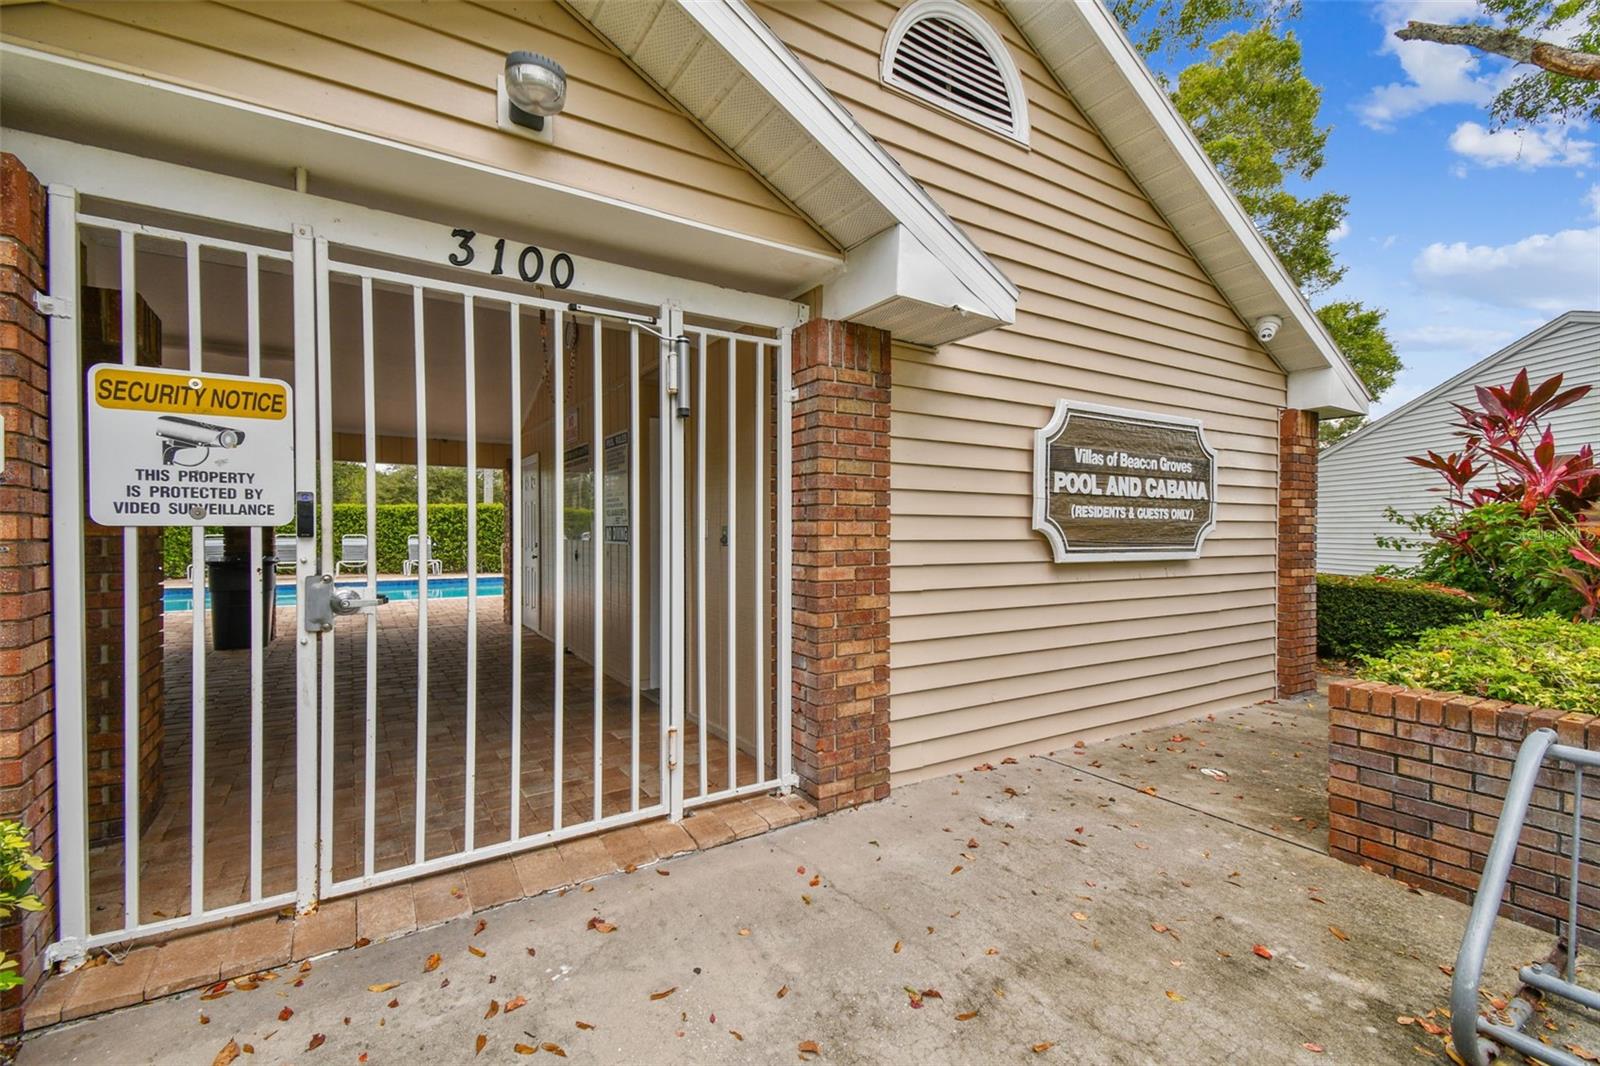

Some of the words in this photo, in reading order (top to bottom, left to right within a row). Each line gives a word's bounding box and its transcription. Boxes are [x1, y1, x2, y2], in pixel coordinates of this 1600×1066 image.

[448, 228, 575, 290] 3100
[98, 378, 207, 407] SECURITY
[210, 387, 285, 413] NOTICE
[1074, 447, 1104, 466] Villas
[1106, 451, 1119, 466] of
[1120, 452, 1158, 471] Beacon
[1160, 456, 1193, 473] Groves
[135, 468, 170, 482] THIS
[178, 469, 256, 485] PROPERTY
[1053, 471, 1103, 496] POOL
[1106, 475, 1142, 498] AND
[1145, 477, 1209, 500] CABANA
[126, 484, 141, 498] IS
[149, 485, 237, 500] PROTECTED
[244, 487, 264, 500] BY
[113, 501, 161, 515] VIDEO
[1071, 503, 1127, 519] (RESIDENTS
[1128, 506, 1135, 519] &
[1137, 507, 1170, 520] GUESTS
[1171, 509, 1194, 521] ONLY)
